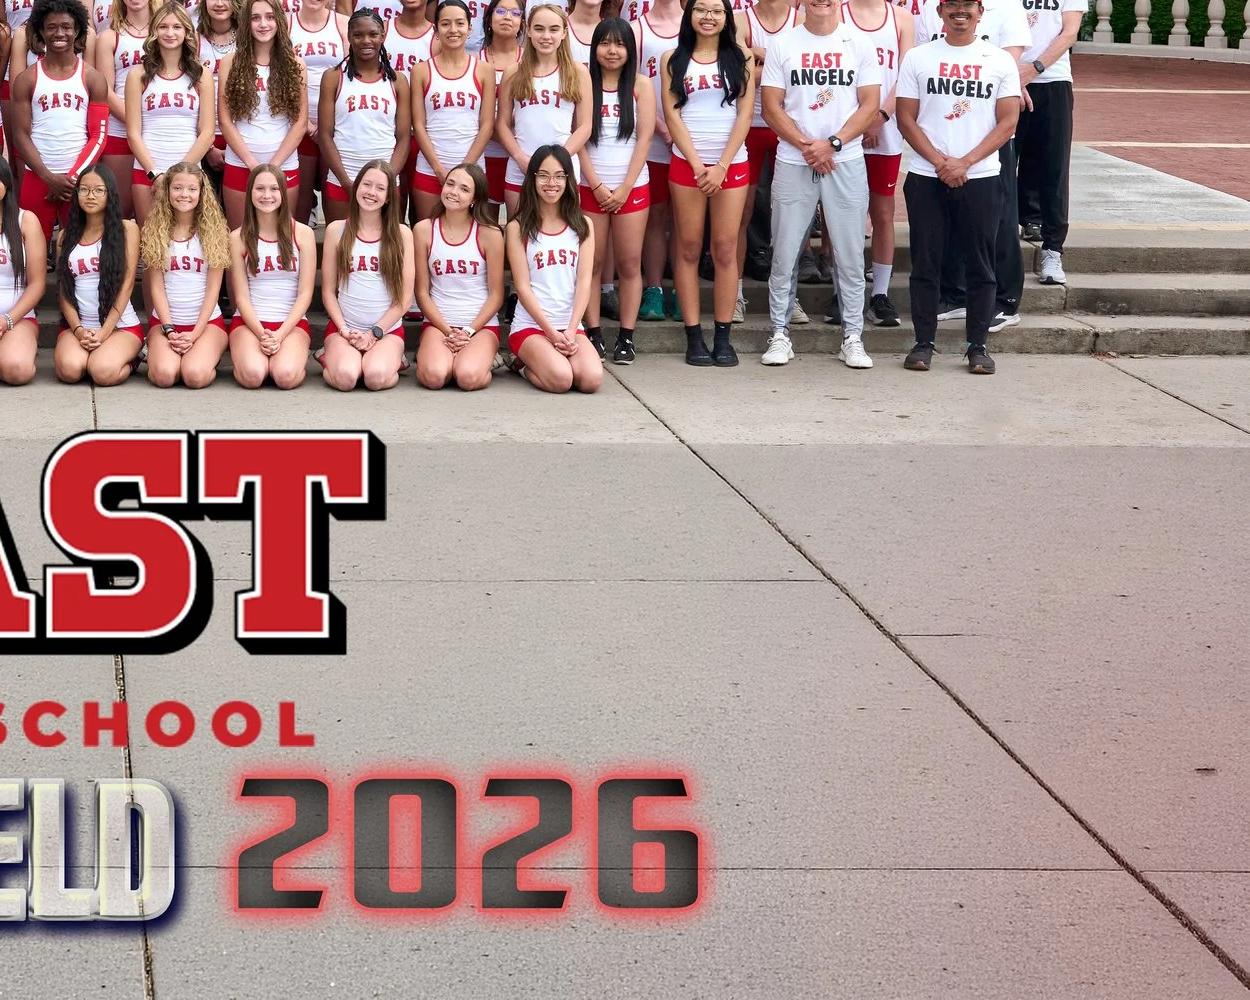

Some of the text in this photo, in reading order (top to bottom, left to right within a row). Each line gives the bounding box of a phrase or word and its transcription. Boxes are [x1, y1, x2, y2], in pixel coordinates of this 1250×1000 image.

[629, 1, 649, 21] EA
[120, 50, 143, 68] EA
[801, 53, 842, 68] EAST
[790, 69, 855, 87] ANGELS
[939, 62, 982, 80] EAST
[684, 75, 724, 95] EAS
[926, 78, 994, 99] ANGELS
[38, 93, 84, 112] EAST
[146, 93, 196, 111] EAST
[346, 95, 390, 114] EAST
[431, 92, 477, 110] EAST
[601, 104, 620, 117] AS
[170, 256, 204, 272] AST
[432, 259, 479, 275] EAST
[534, 249, 577, 270] EAST
